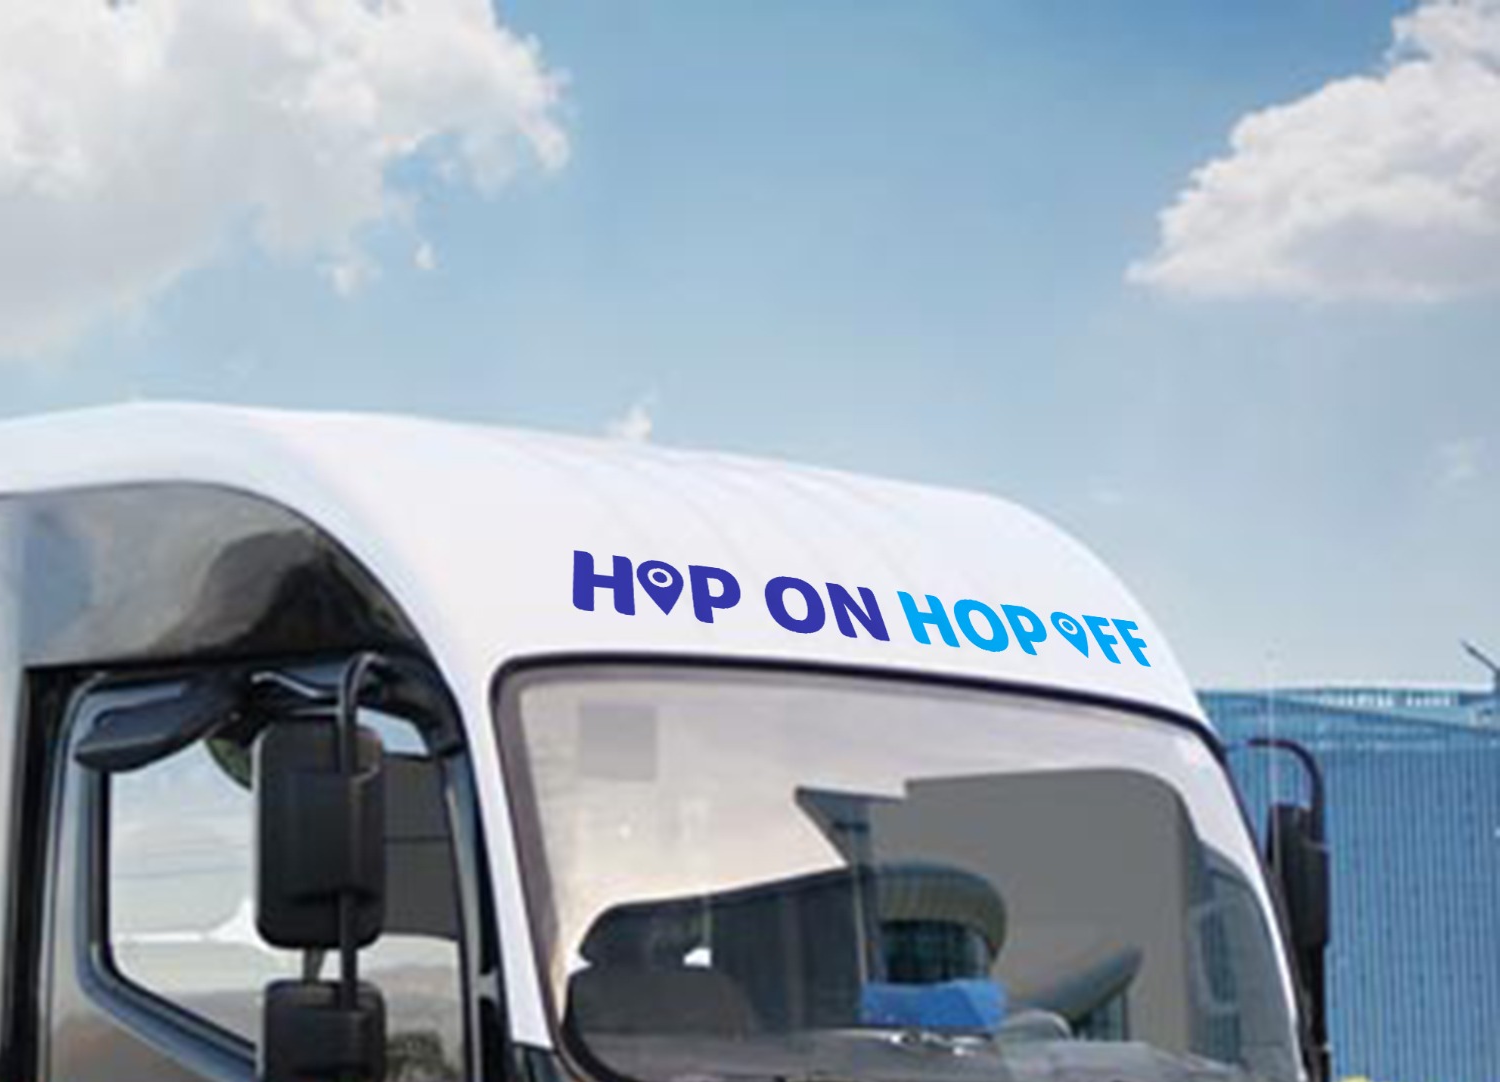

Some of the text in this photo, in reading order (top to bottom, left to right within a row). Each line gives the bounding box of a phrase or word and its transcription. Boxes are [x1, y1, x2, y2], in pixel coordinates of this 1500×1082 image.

[572, 550, 1152, 667] HOP ON HOP OFF
